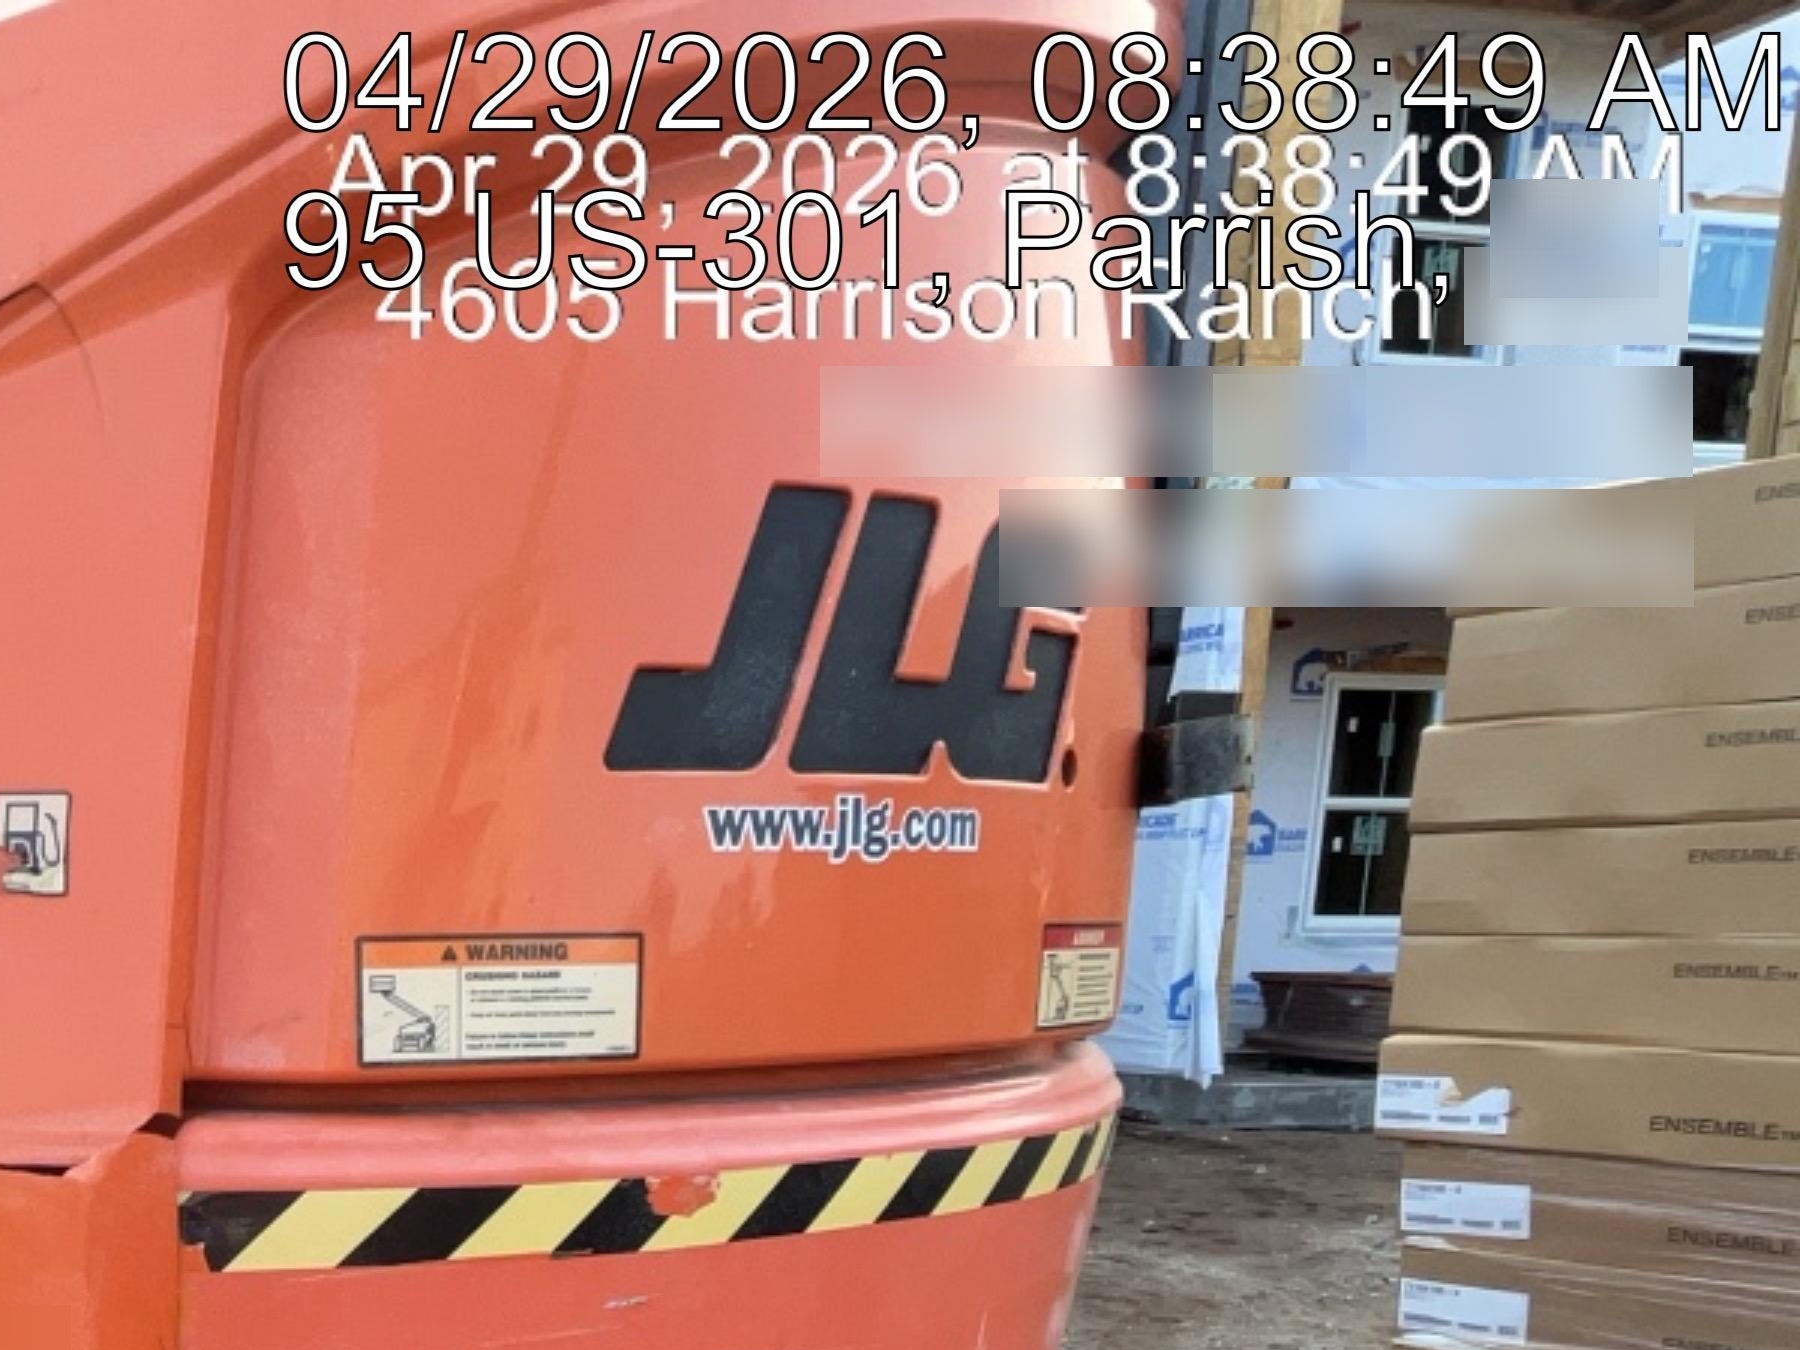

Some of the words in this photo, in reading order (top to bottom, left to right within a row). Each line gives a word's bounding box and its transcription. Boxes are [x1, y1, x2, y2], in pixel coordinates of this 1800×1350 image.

[603, 480, 1087, 785] JLG
[704, 796, 979, 858] www.jlg.com
[465, 942, 569, 962] WARNING
